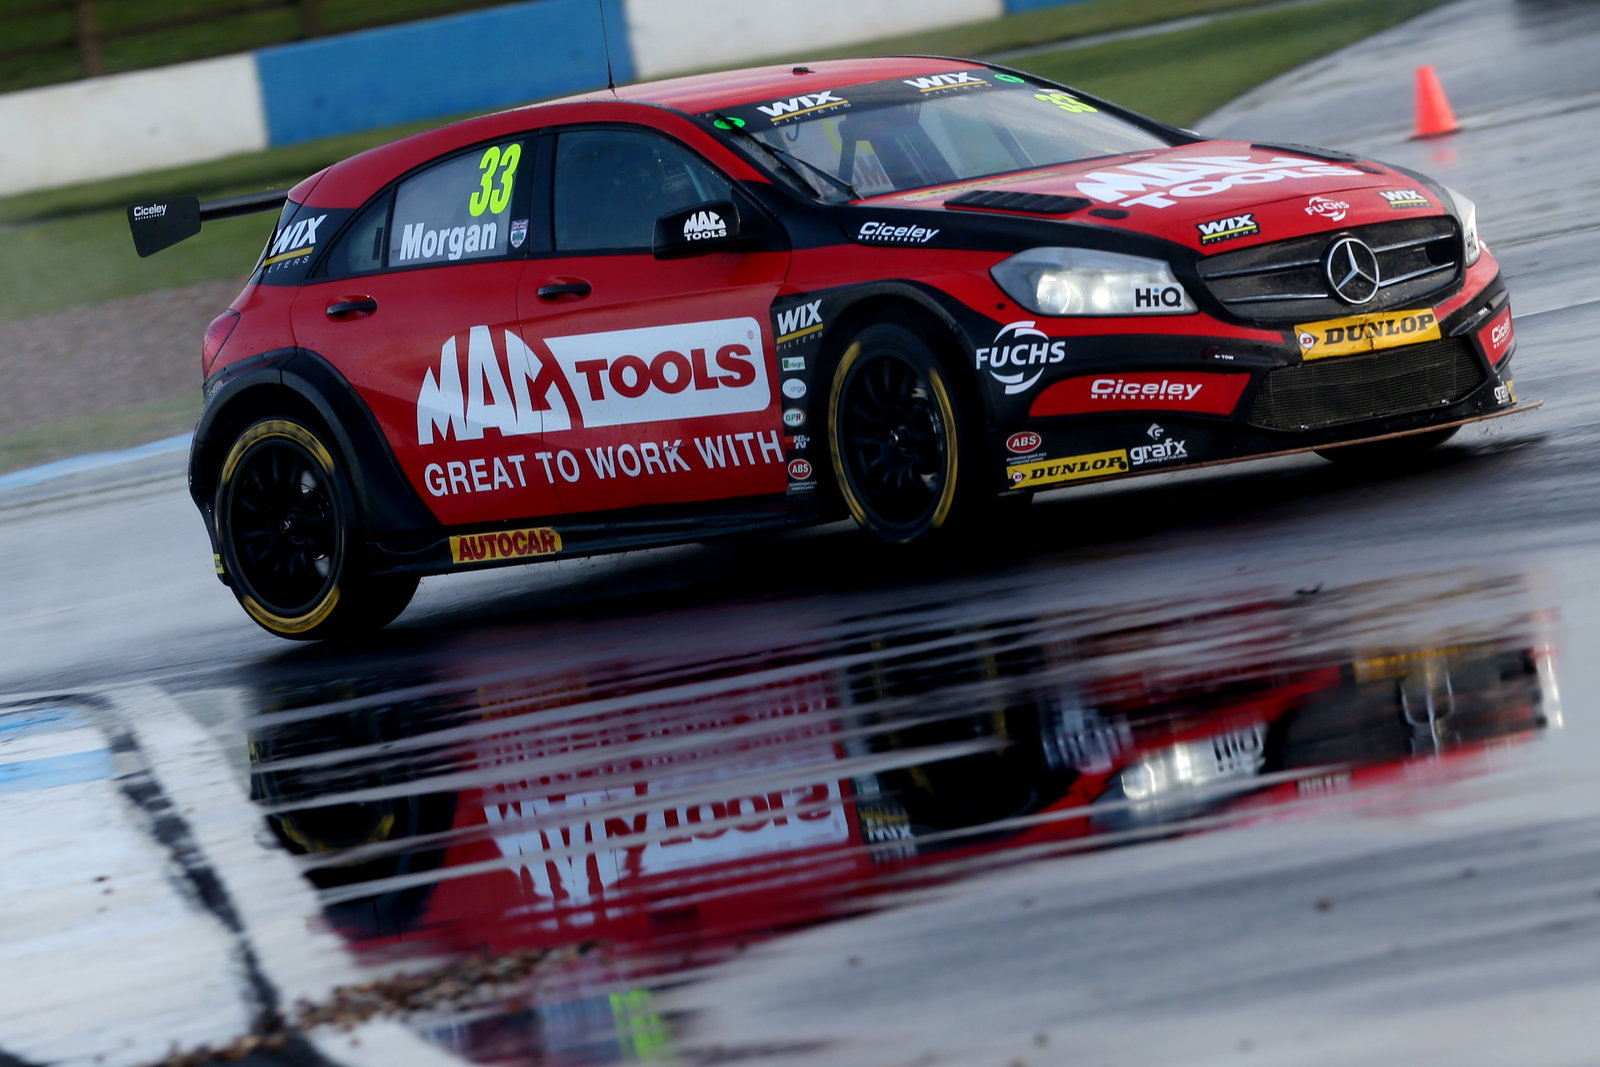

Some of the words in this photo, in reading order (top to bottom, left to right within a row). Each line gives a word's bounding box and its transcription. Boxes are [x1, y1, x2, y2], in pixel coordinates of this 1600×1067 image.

[902, 72, 982, 89] WIX
[756, 90, 844, 117] WIX
[469, 143, 522, 217] 33
[1118, 164, 1365, 209] TOOLS
[1378, 190, 1425, 201] WIX
[134, 203, 168, 217] Ciceley
[1304, 200, 1350, 217] FUCHS
[683, 210, 727, 234] MAC
[860, 221, 940, 243] Ciceley
[1198, 213, 1256, 236] WIX
[269, 214, 328, 258] WIX
[400, 222, 498, 261] Morgan
[683, 228, 727, 242] TOOLS
[1135, 286, 1182, 308] HiQ
[777, 298, 823, 336] WIX
[776, 330, 823, 352] FILTERS
[1323, 313, 1435, 346] DUNLOP
[976, 341, 1066, 370] FUCHS
[417, 325, 572, 445] MAC
[575, 344, 756, 401] TOOLS
[1091, 378, 1203, 400] Ciceley
[1012, 435, 1037, 448] ABS
[1130, 437, 1187, 465] grafx
[424, 455, 528, 497] GREAT
[536, 450, 581, 484] TO
[585, 439, 691, 480] WORK
[694, 430, 785, 472] WITH
[792, 464, 809, 474] ABS
[1029, 457, 1123, 479] DUNLOP
[458, 528, 556, 562] AUTOCAR
